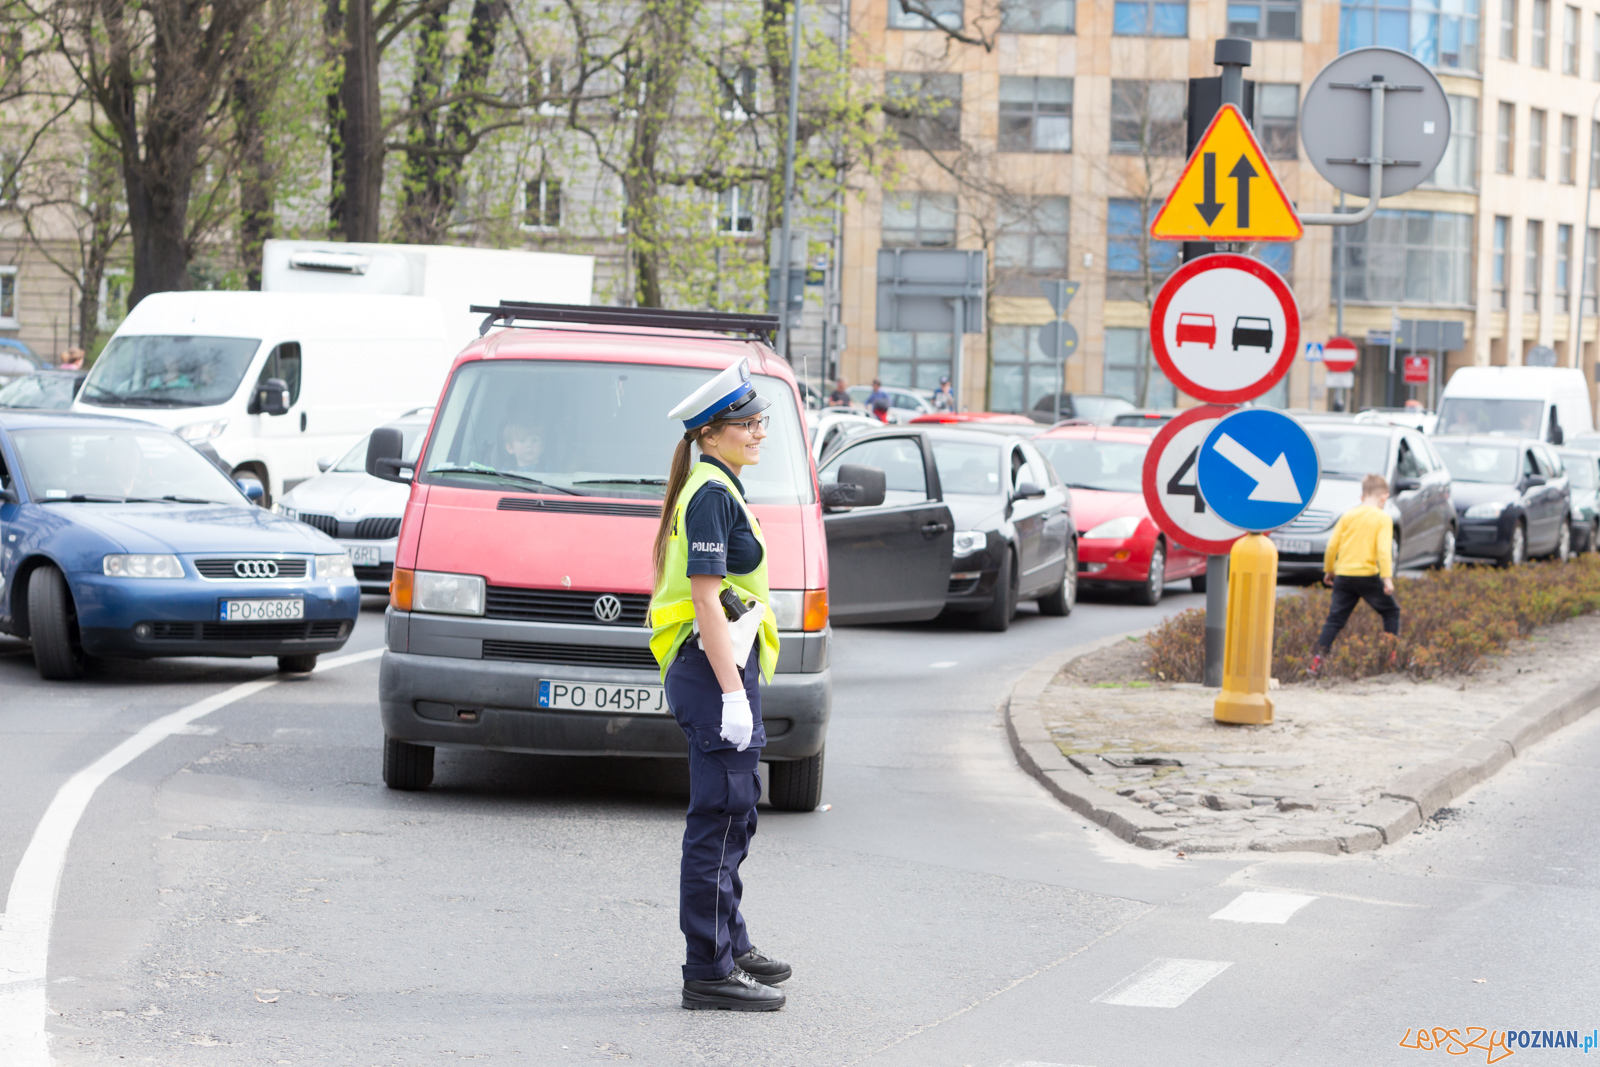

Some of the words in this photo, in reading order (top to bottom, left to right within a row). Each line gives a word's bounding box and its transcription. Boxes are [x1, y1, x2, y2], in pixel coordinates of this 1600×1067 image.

[1166, 444, 1206, 514] 4
[348, 546, 376, 561] 16RL
[692, 541, 724, 553] POLICJA
[230, 602, 252, 620] PO
[257, 601, 301, 619] 6G865
[539, 696, 549, 704] PL
[553, 684, 586, 707] PO
[595, 687, 664, 711] 045PJ
